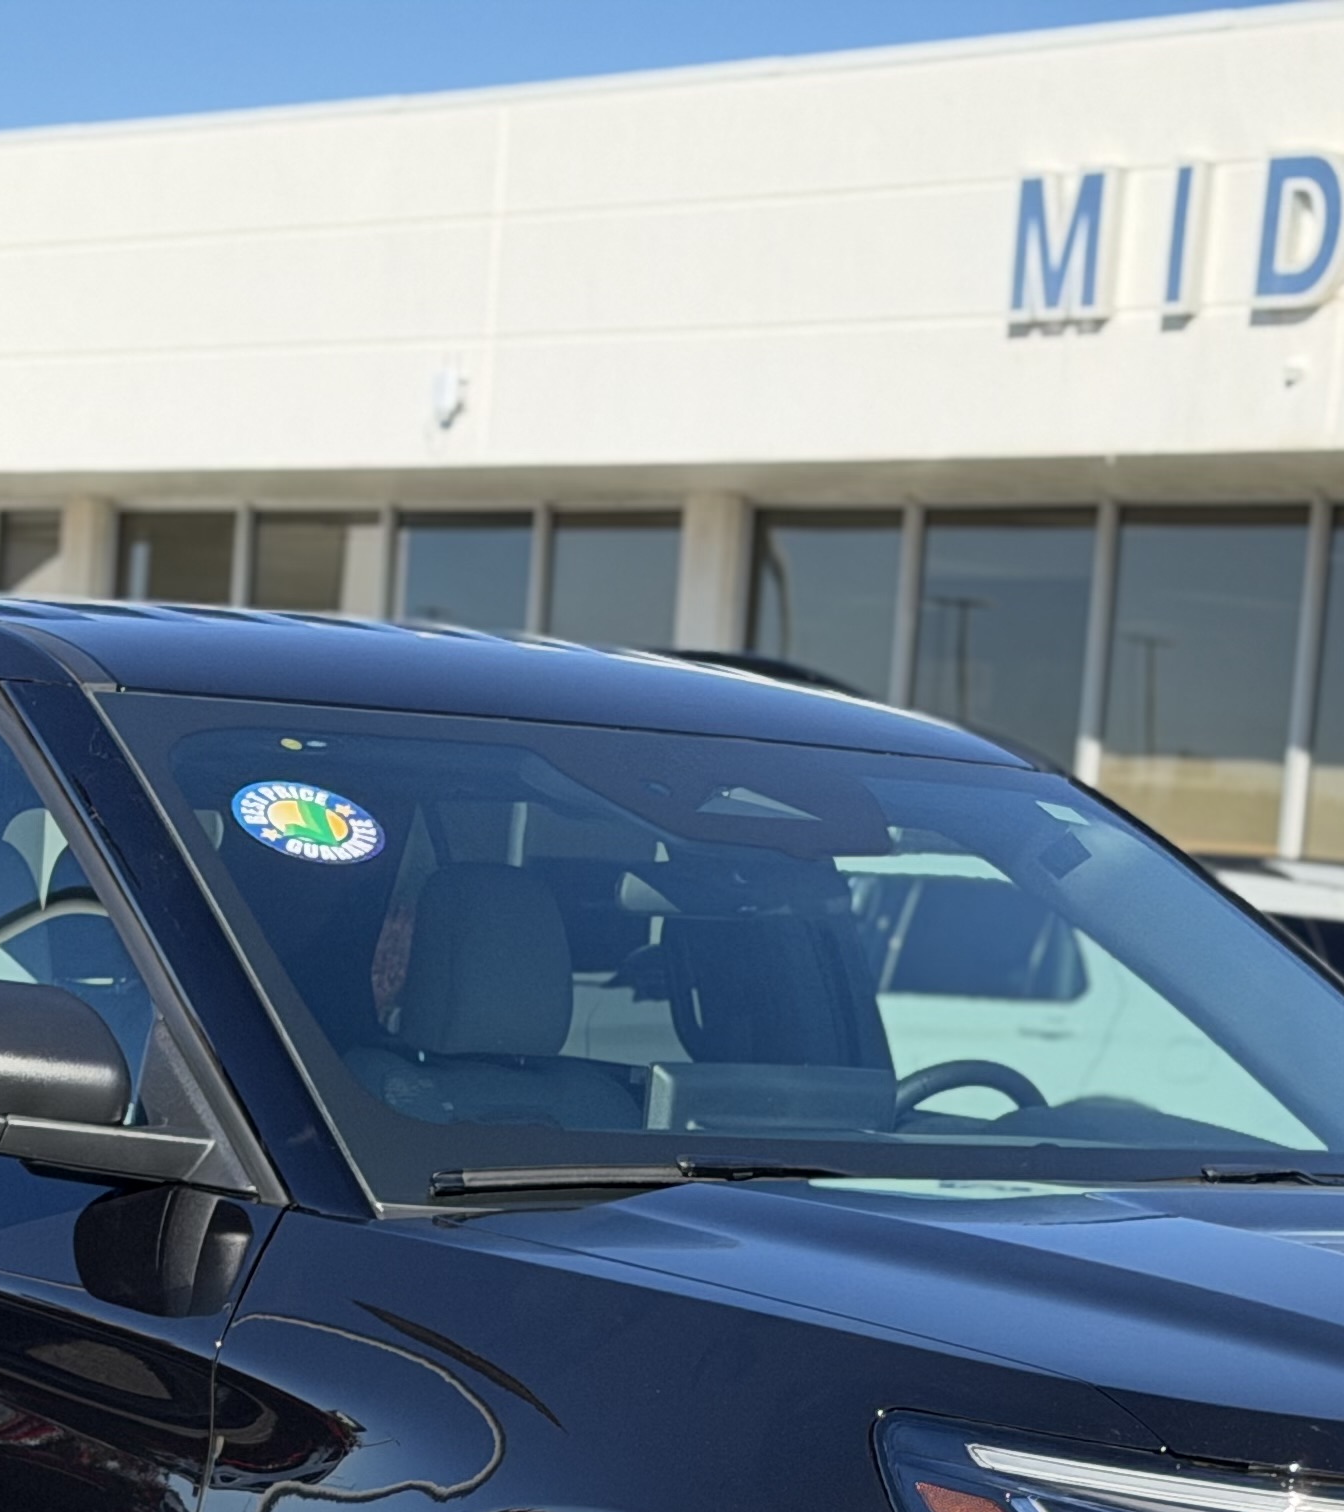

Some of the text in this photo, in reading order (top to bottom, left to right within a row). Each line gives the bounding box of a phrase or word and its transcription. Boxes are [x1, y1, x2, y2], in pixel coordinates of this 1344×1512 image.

[240, 784, 329, 825] BEST PRICE
[285, 818, 378, 861] GUARANTEE
